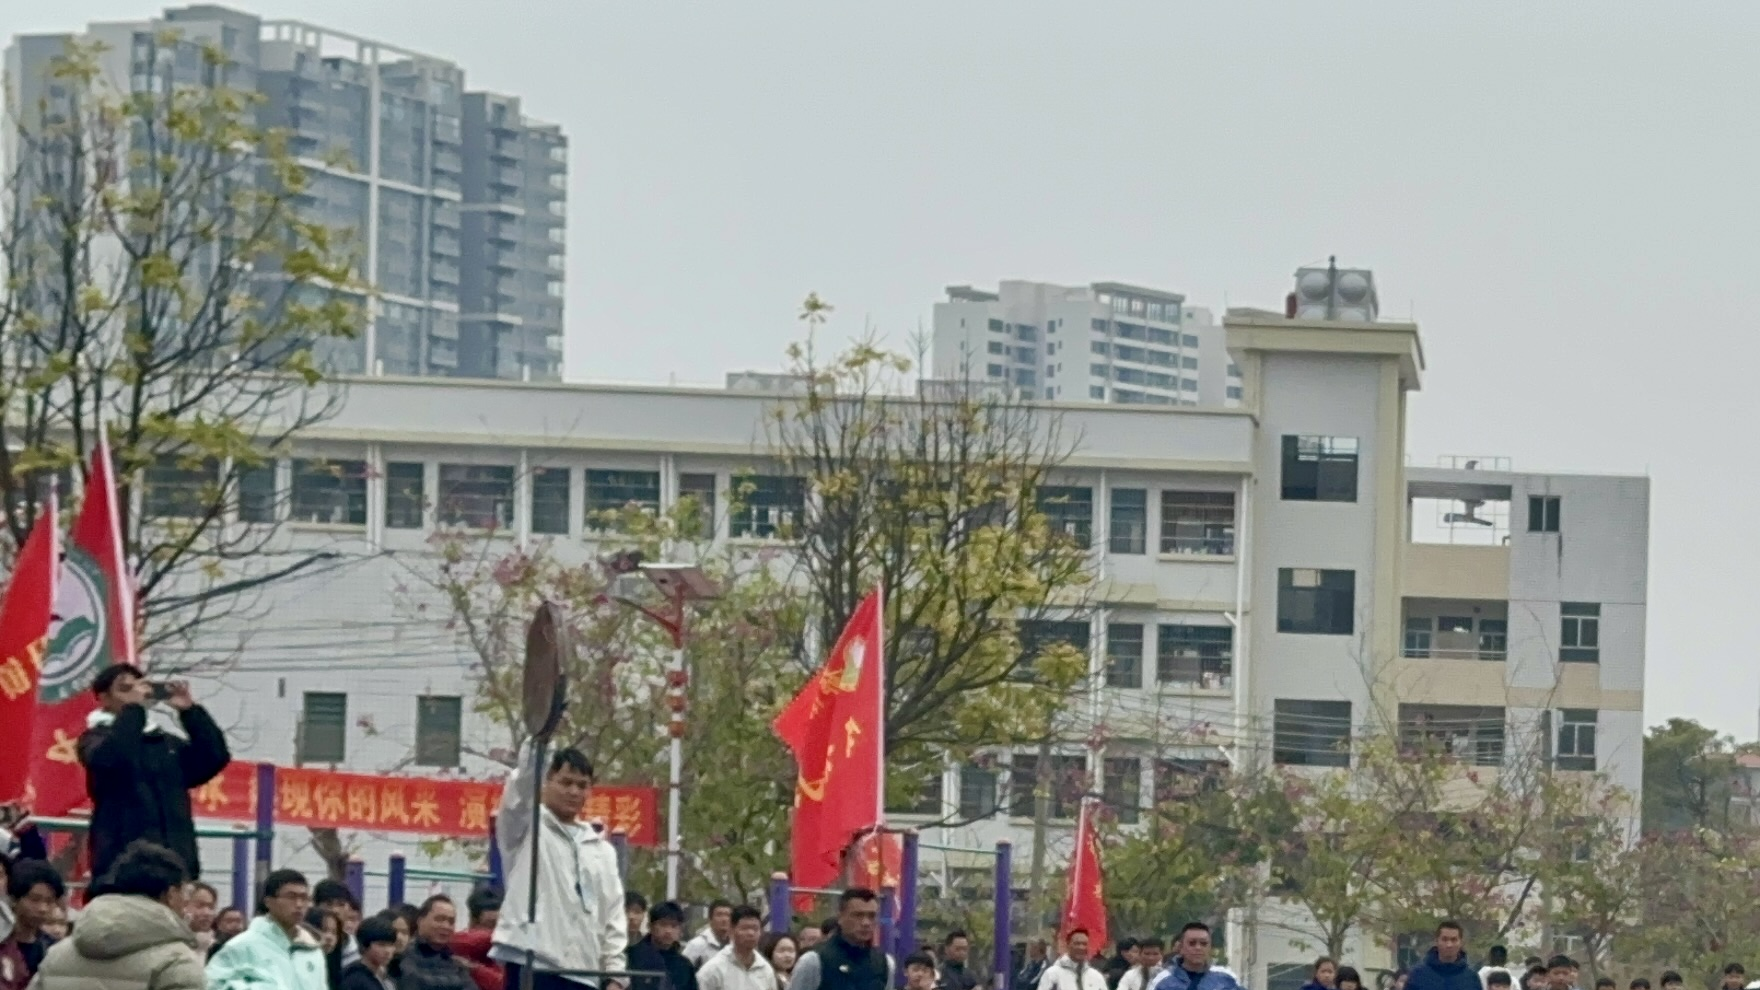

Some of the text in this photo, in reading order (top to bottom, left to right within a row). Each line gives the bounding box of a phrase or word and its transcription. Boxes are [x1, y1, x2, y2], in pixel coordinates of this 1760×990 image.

[248, 777, 441, 828] 现你的风采
